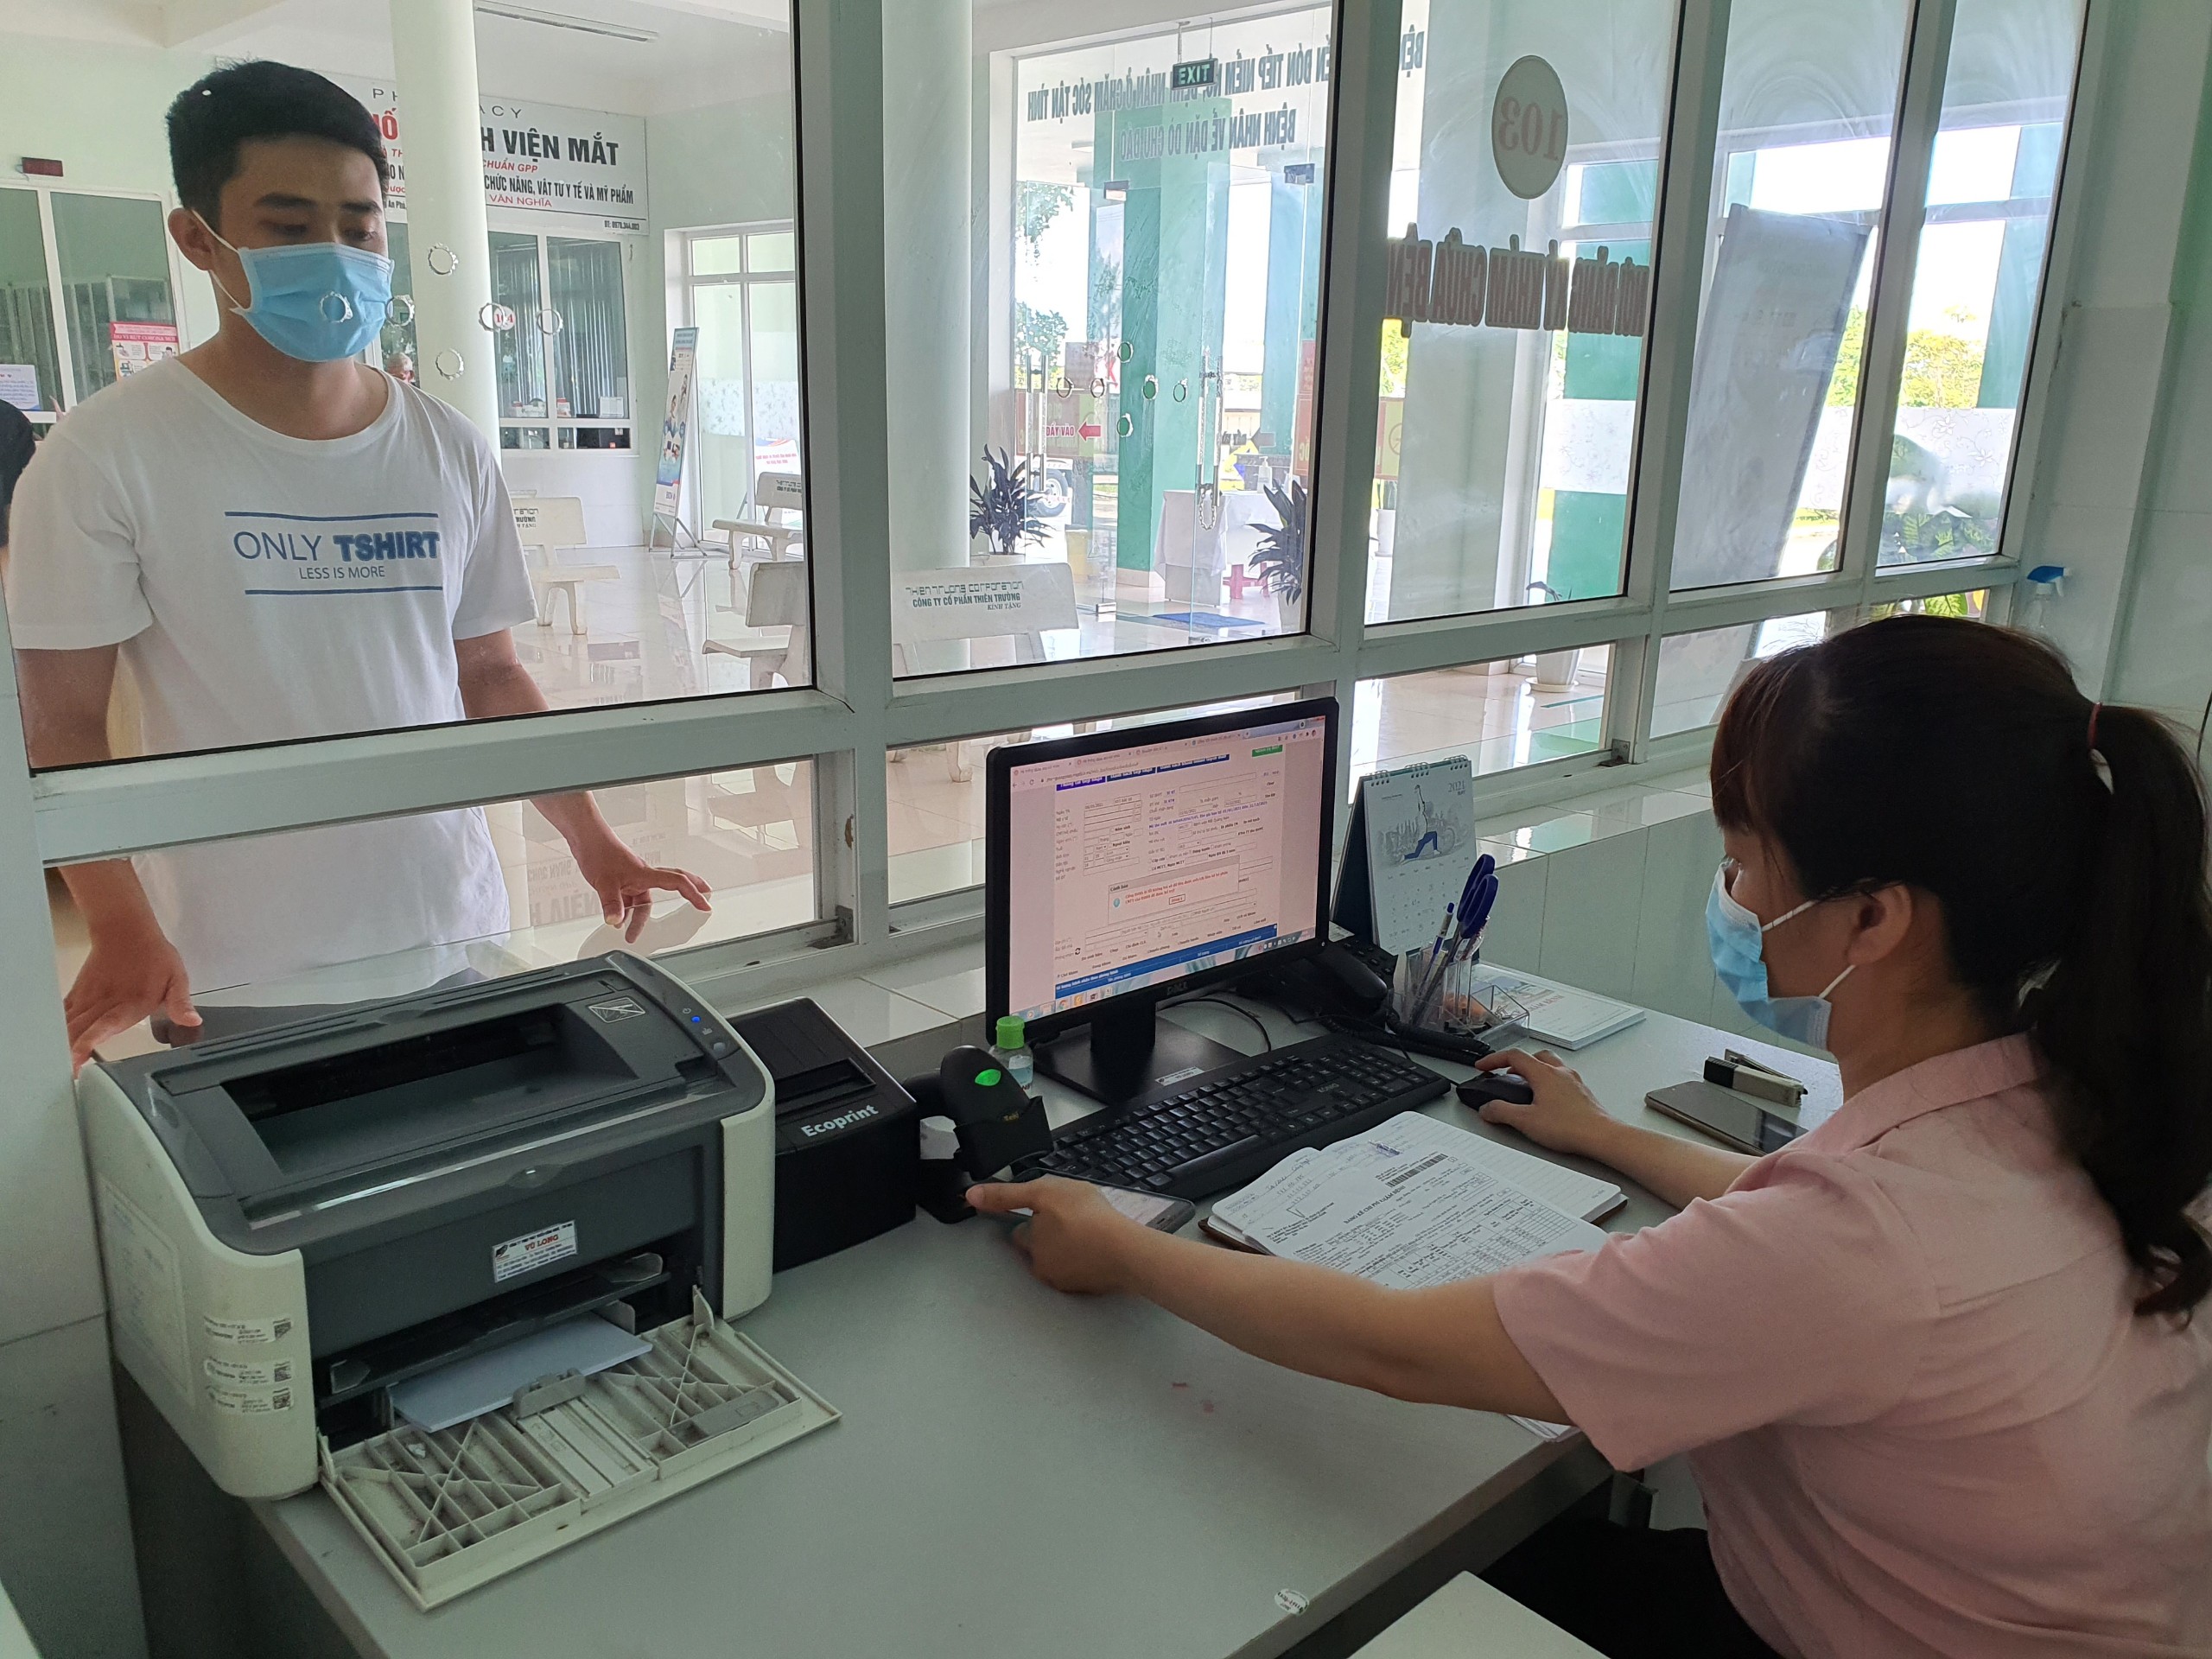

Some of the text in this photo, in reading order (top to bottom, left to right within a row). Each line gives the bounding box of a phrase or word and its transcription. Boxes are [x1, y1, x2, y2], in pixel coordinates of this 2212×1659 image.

[1178, 64, 1211, 85] EXIT
[502, 128, 561, 162] VIỆN
[568, 132, 619, 166] MẮT
[518, 163, 538, 173] GPP
[484, 173, 507, 191] CHỨC
[510, 175, 536, 195] NĂNG,
[573, 181, 582, 199] TẾ
[584, 183, 594, 200] VÀ
[610, 184, 633, 204] PHẨM
[233, 531, 440, 562] ONLY TSHIRT
[299, 566, 385, 579] LESS IS MORE
[912, 596, 931, 607] CÔNG
[933, 597, 941, 607] TY
[1447, 779, 1465, 792] 2021
[800, 1105, 879, 1137] Ecoprint
